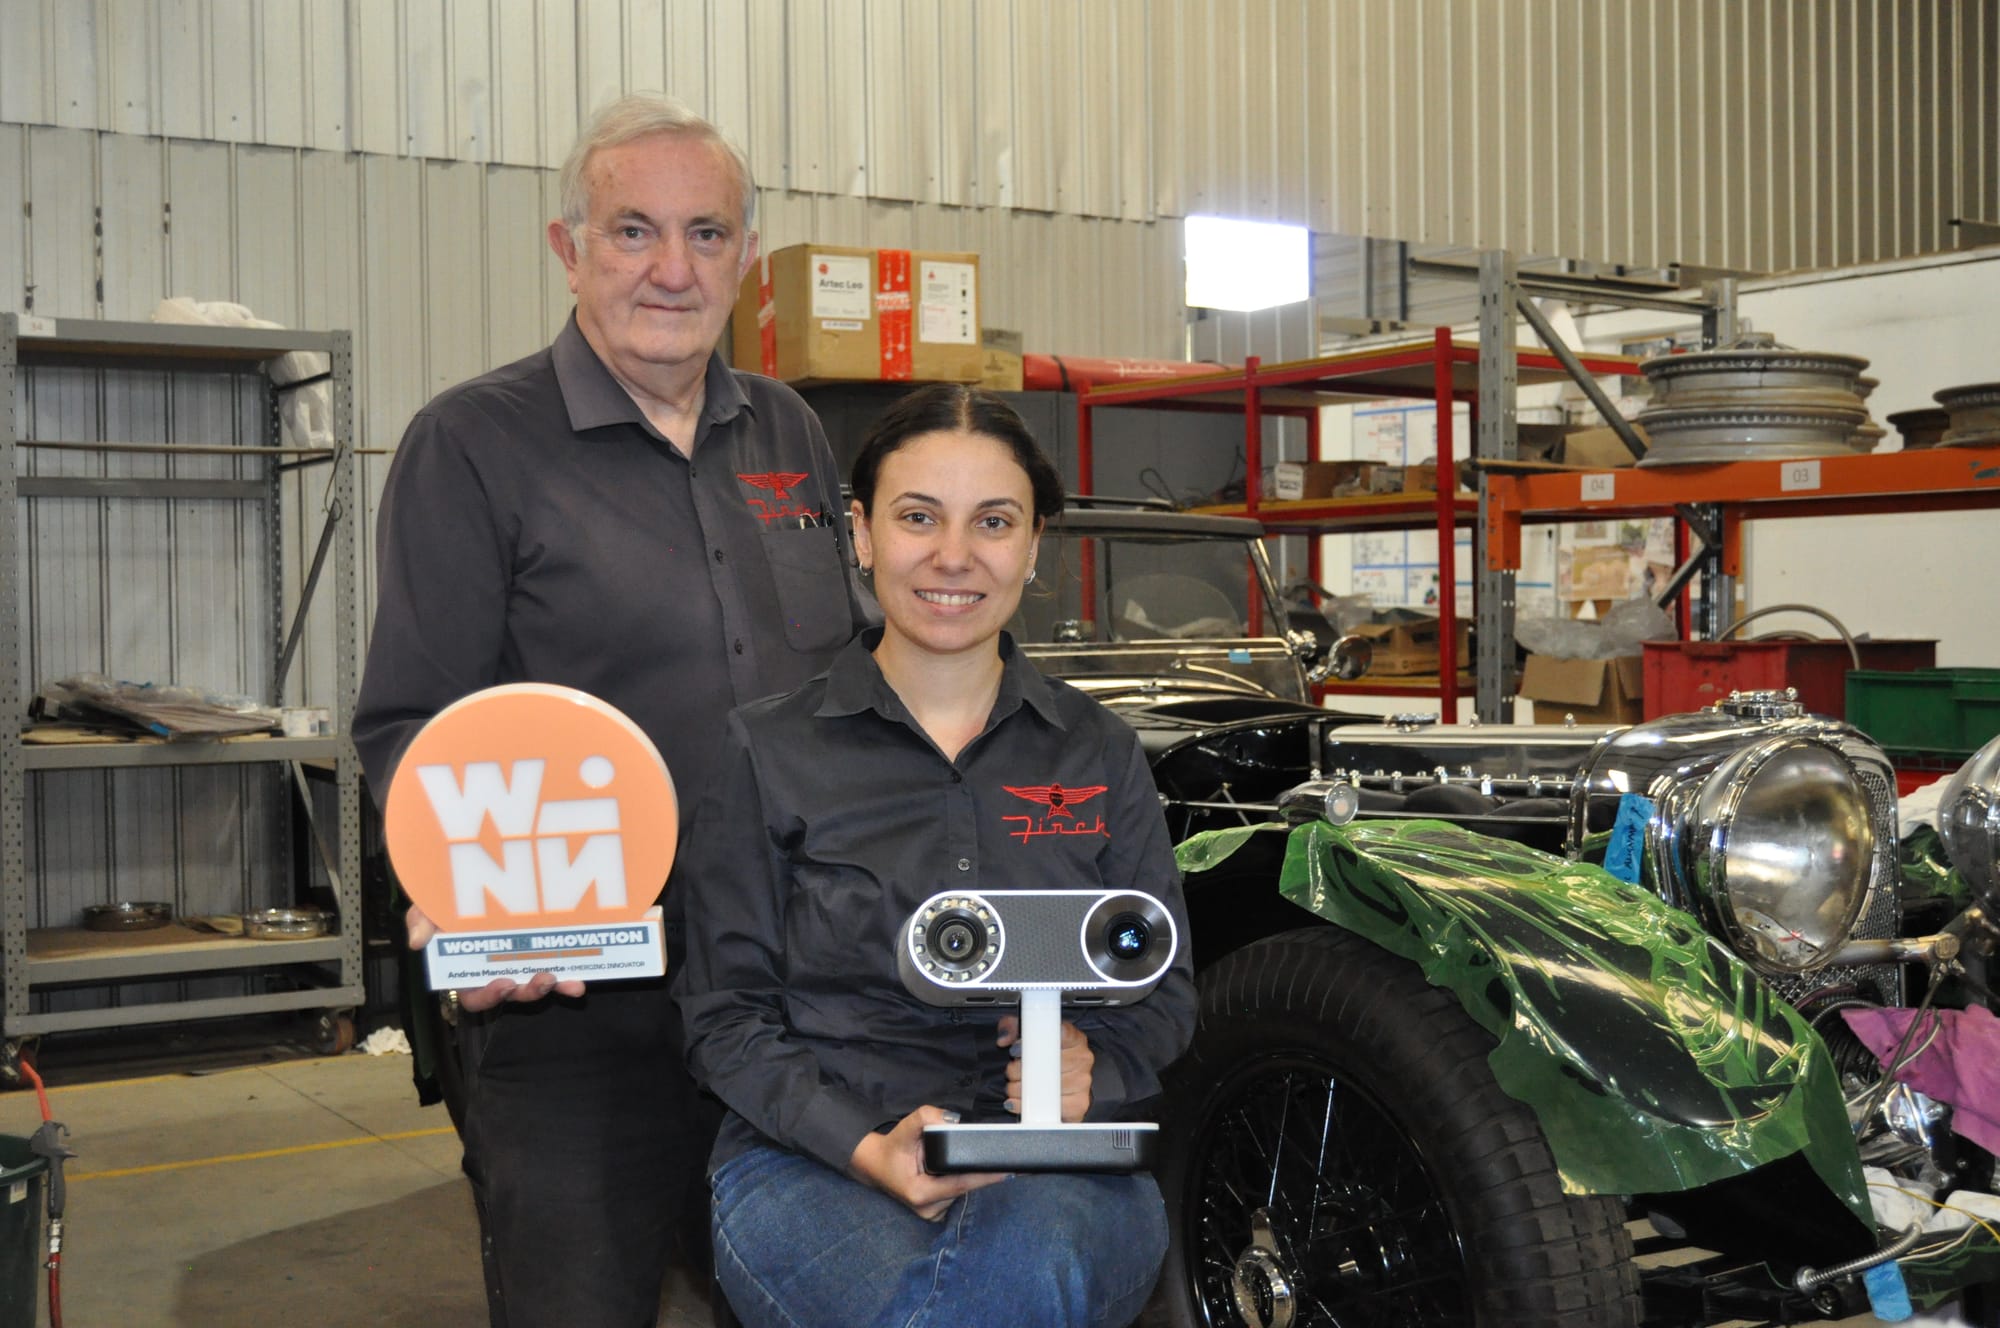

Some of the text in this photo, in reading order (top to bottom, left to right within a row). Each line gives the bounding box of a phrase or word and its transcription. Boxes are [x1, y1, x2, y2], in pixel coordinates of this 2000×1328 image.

[818, 278, 864, 290] Artec Leo
[1793, 467, 1808, 484] 03
[1591, 478, 1605, 492] 04
[1001, 815, 1111, 844] Finch
[443, 938, 513, 954] WOMEN
[531, 930, 644, 949] INNOVATION
[448, 969, 481, 979] Andrea
[607, 961, 645, 969] INNOVATOR
